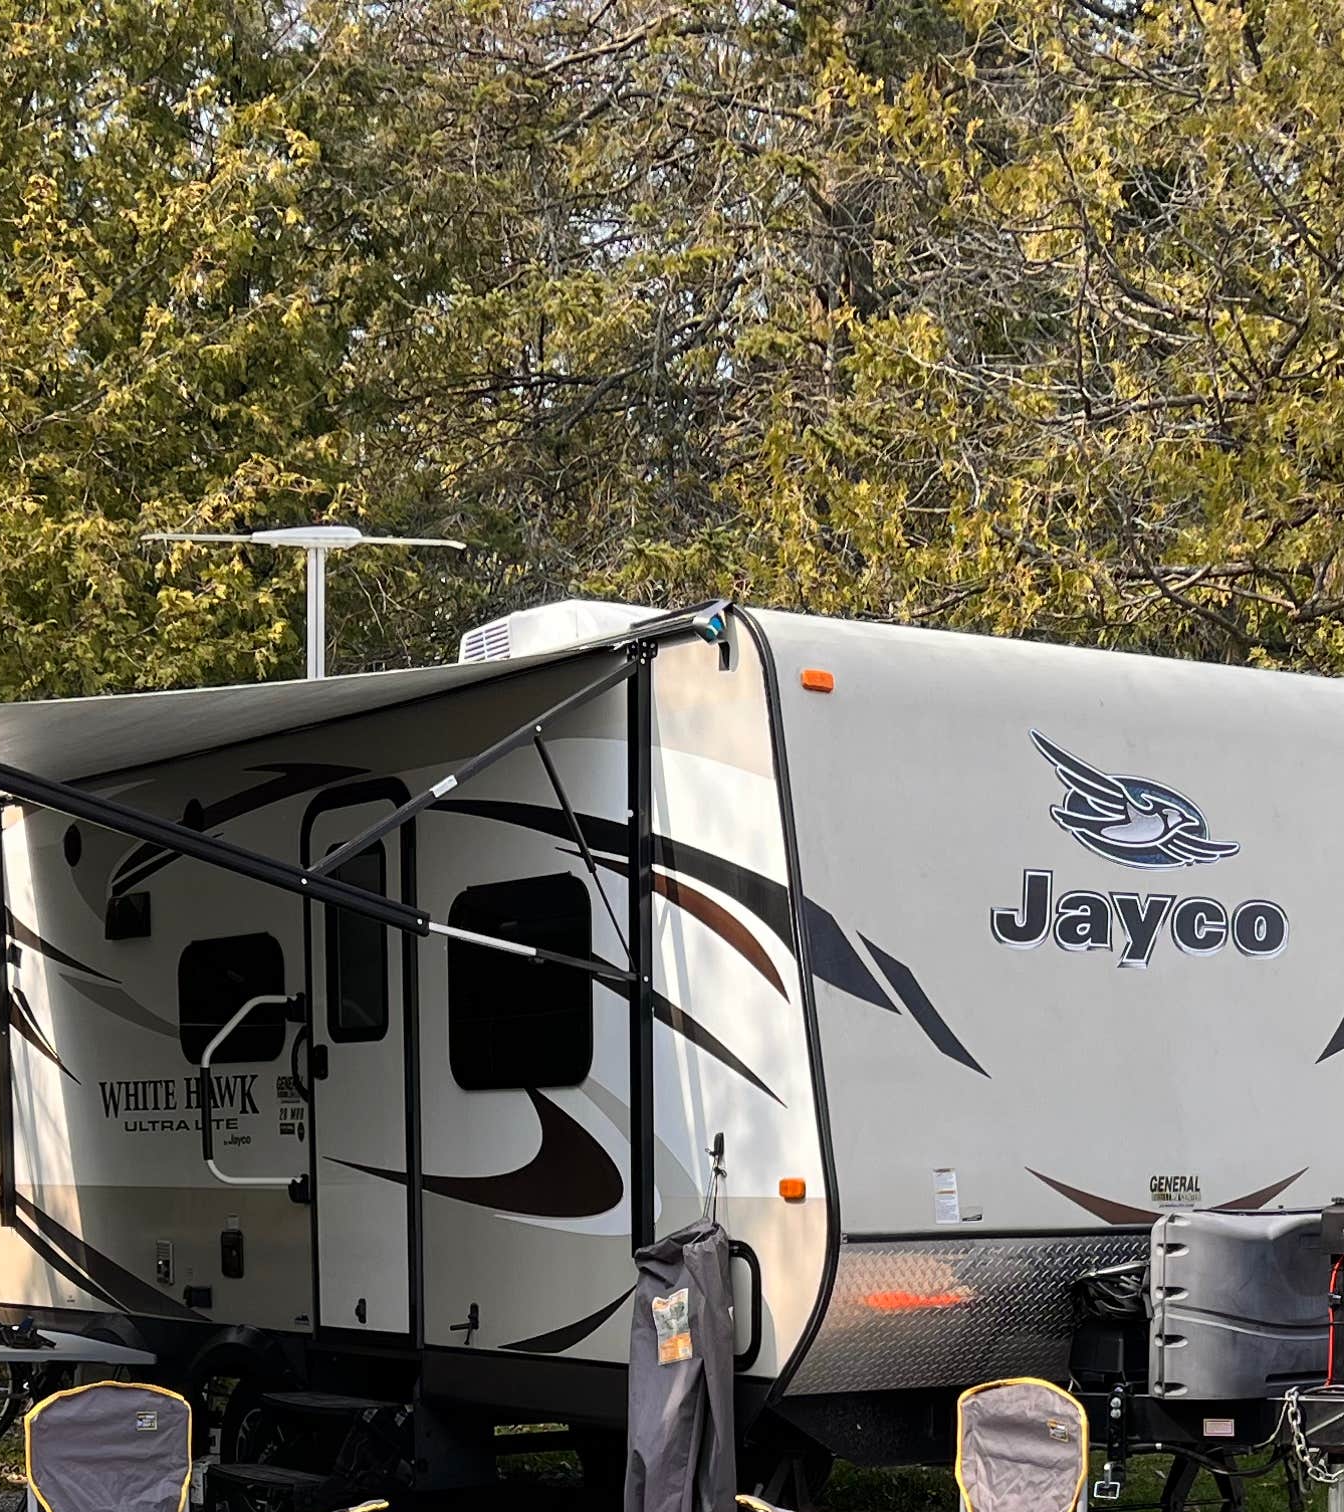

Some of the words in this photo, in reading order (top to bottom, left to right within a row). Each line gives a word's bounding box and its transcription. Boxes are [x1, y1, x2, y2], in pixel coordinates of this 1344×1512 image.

[990, 869, 1289, 969] Jayco
[99, 1080, 177, 1119] WHITE
[124, 1119, 190, 1132] ULTRA
[195, 1118, 238, 1131] LTE
[1149, 1175, 1201, 1193] GENERAL
